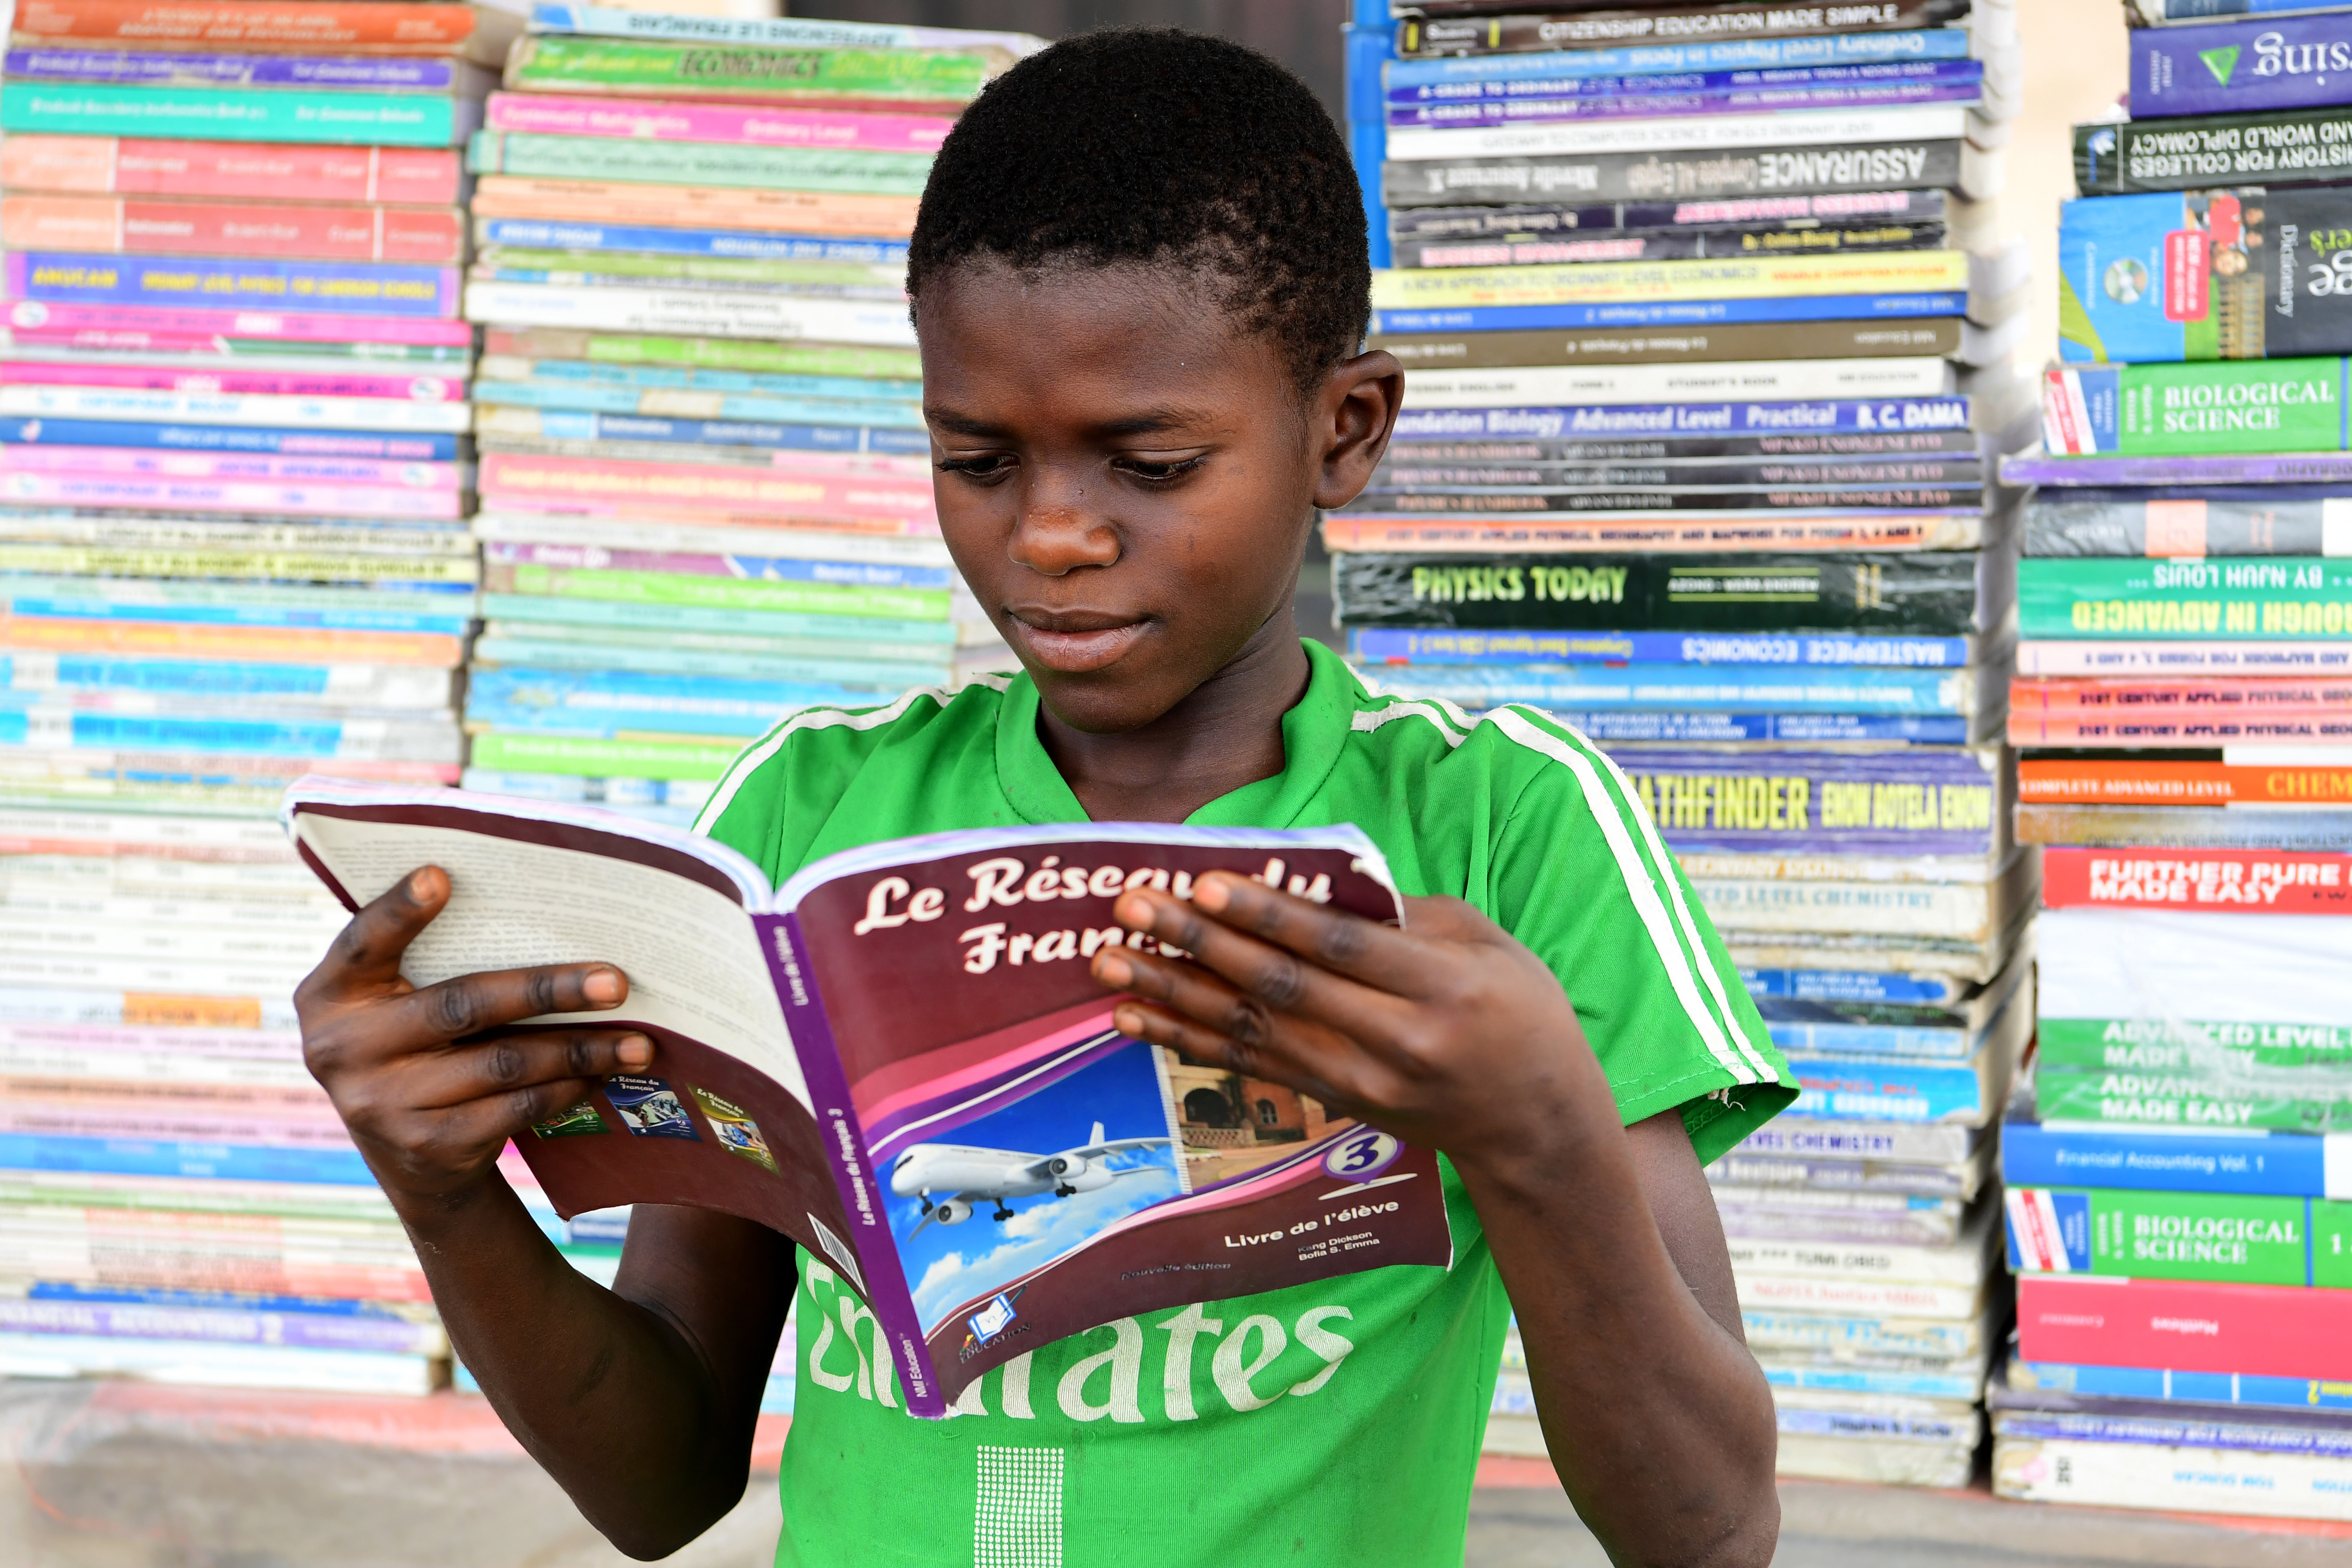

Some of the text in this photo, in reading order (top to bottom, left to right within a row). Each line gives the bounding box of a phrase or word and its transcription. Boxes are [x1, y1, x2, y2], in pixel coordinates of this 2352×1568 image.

[1538, 3, 1897, 41] CITIZENSHIP EDUCATION MADE SIMPLE
[1783, 39, 1835, 59] Level
[1838, 33, 1925, 55] Ordinary
[2130, 125, 2317, 154] WORLD DIPLOMACY
[1759, 147, 1926, 187] ASSURANCE
[2129, 152, 2231, 178] COLLEGES
[2234, 150, 2274, 172] FOR
[2276, 224, 2298, 317] Dictionary
[2164, 380, 2335, 409] BIOLOGICAL
[1487, 406, 1565, 437] Biology
[1572, 407, 1674, 430] Advanced
[1677, 405, 1732, 430] Level
[1747, 403, 1836, 429] Practical
[1904, 403, 1965, 428] DAMA
[2164, 406, 2281, 434] SCIENCE
[1413, 566, 1627, 603] PHYSICS TODAY
[2153, 564, 2323, 589] BY NJUH LOUIS
[2072, 600, 2257, 633] IN ADVANCED
[1681, 638, 1945, 664] MASTERPIECE ECONOMICS
[2103, 780, 2185, 797] ADVANCED
[2188, 781, 2235, 798] LEVEL
[2088, 859, 2340, 885] FURTHER PURE
[1812, 890, 1933, 909] CHEMISTRY
[2090, 879, 2283, 904] MADE EASY
[854, 875, 945, 936] Le
[782, 962, 800, 978] de
[789, 977, 809, 1006] Livre
[2260, 1024, 2345, 1050] LEVEL
[2103, 1045, 2183, 1066] MADE
[2101, 1098, 2254, 1124] MADE EASY
[1343, 1135, 1380, 1171] 3
[2056, 1149, 2123, 1168] Financial
[2126, 1151, 2216, 1175] Accounting
[2218, 1154, 2251, 1173] Vol.
[828, 1108, 876, 1225] Le Réseau du Français 3
[1225, 1200, 1399, 1248] Livre de l'élève
[2133, 1214, 2300, 1244] BIOLOGICAL
[1298, 1230, 1373, 1255] Kang Dickson
[1344, 1238, 1381, 1251] Emma
[2133, 1238, 2249, 1265] SCIENCE
[901, 1339, 928, 1398] NMI Education
